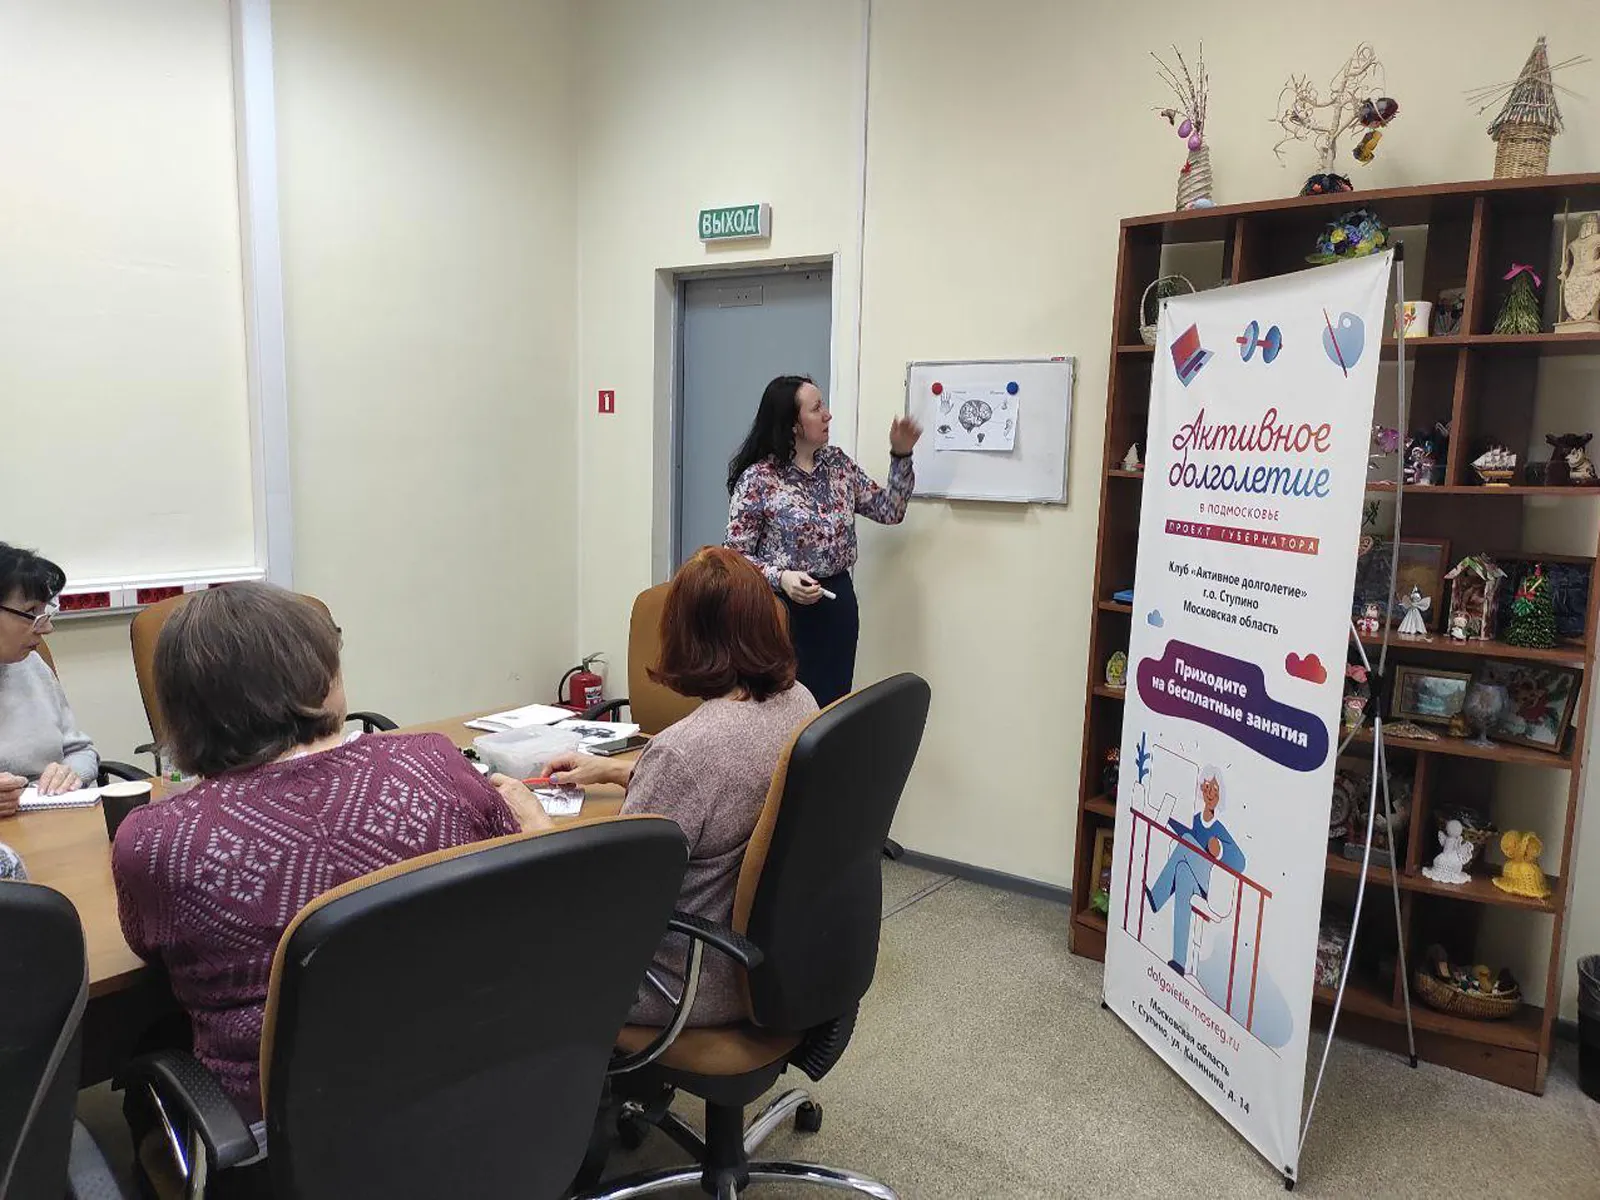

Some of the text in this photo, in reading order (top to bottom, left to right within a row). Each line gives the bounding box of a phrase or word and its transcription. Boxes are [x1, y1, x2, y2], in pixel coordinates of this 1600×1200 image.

[702, 208, 756, 235] ВЫХОД
[1172, 407, 1332, 453] Активное
[1168, 447, 1330, 498] долголетие
[1207, 503, 1280, 521] ПОДМОСКОВЬЕ
[1168, 521, 1316, 552] ПРОЕКТ ГУБЕРНАТОРА
[1168, 560, 1308, 599] Клуб «Активное долголетие»
[1183, 599, 1280, 636] Московская область
[1203, 588, 1260, 611] г.о. Ступино
[1174, 658, 1248, 699] Приходите
[1151, 675, 1309, 749] на бесплатные занятия
[1149, 997, 1230, 1077] Московская область
[1239, 1096, 1251, 1115] 14
